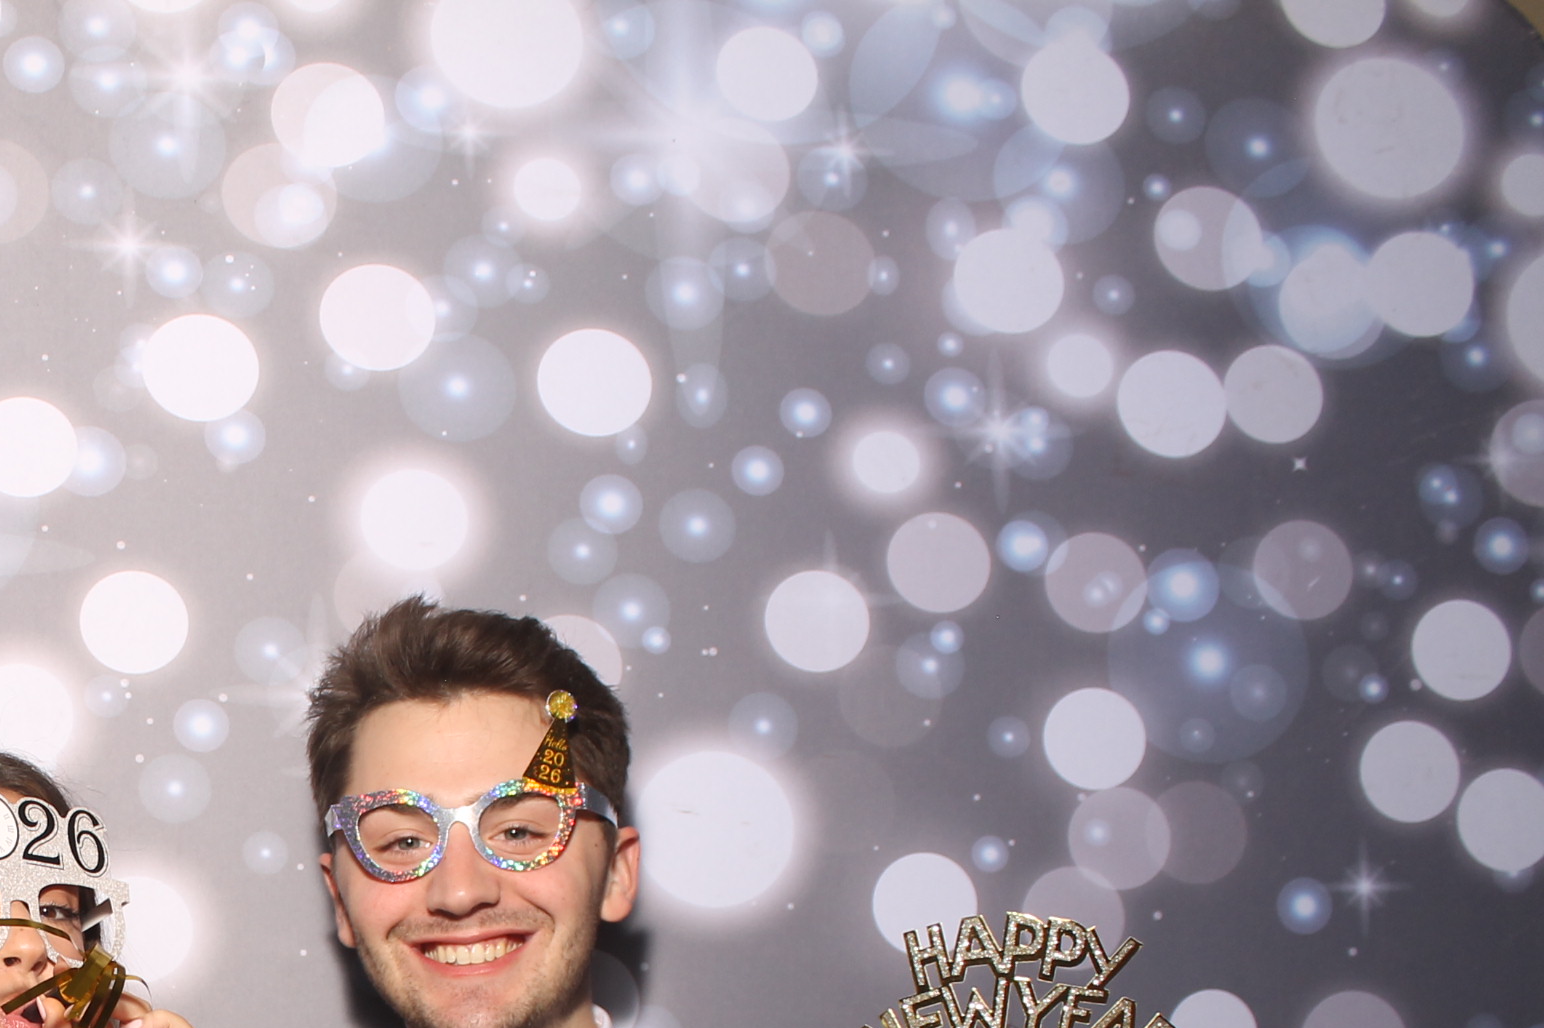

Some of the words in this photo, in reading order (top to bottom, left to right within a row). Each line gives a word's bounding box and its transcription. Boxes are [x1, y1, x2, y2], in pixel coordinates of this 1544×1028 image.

[544, 736, 568, 751] Hello
[543, 748, 565, 766] 20
[538, 764, 561, 783] 26
[902, 911, 1144, 992] HAPPY
